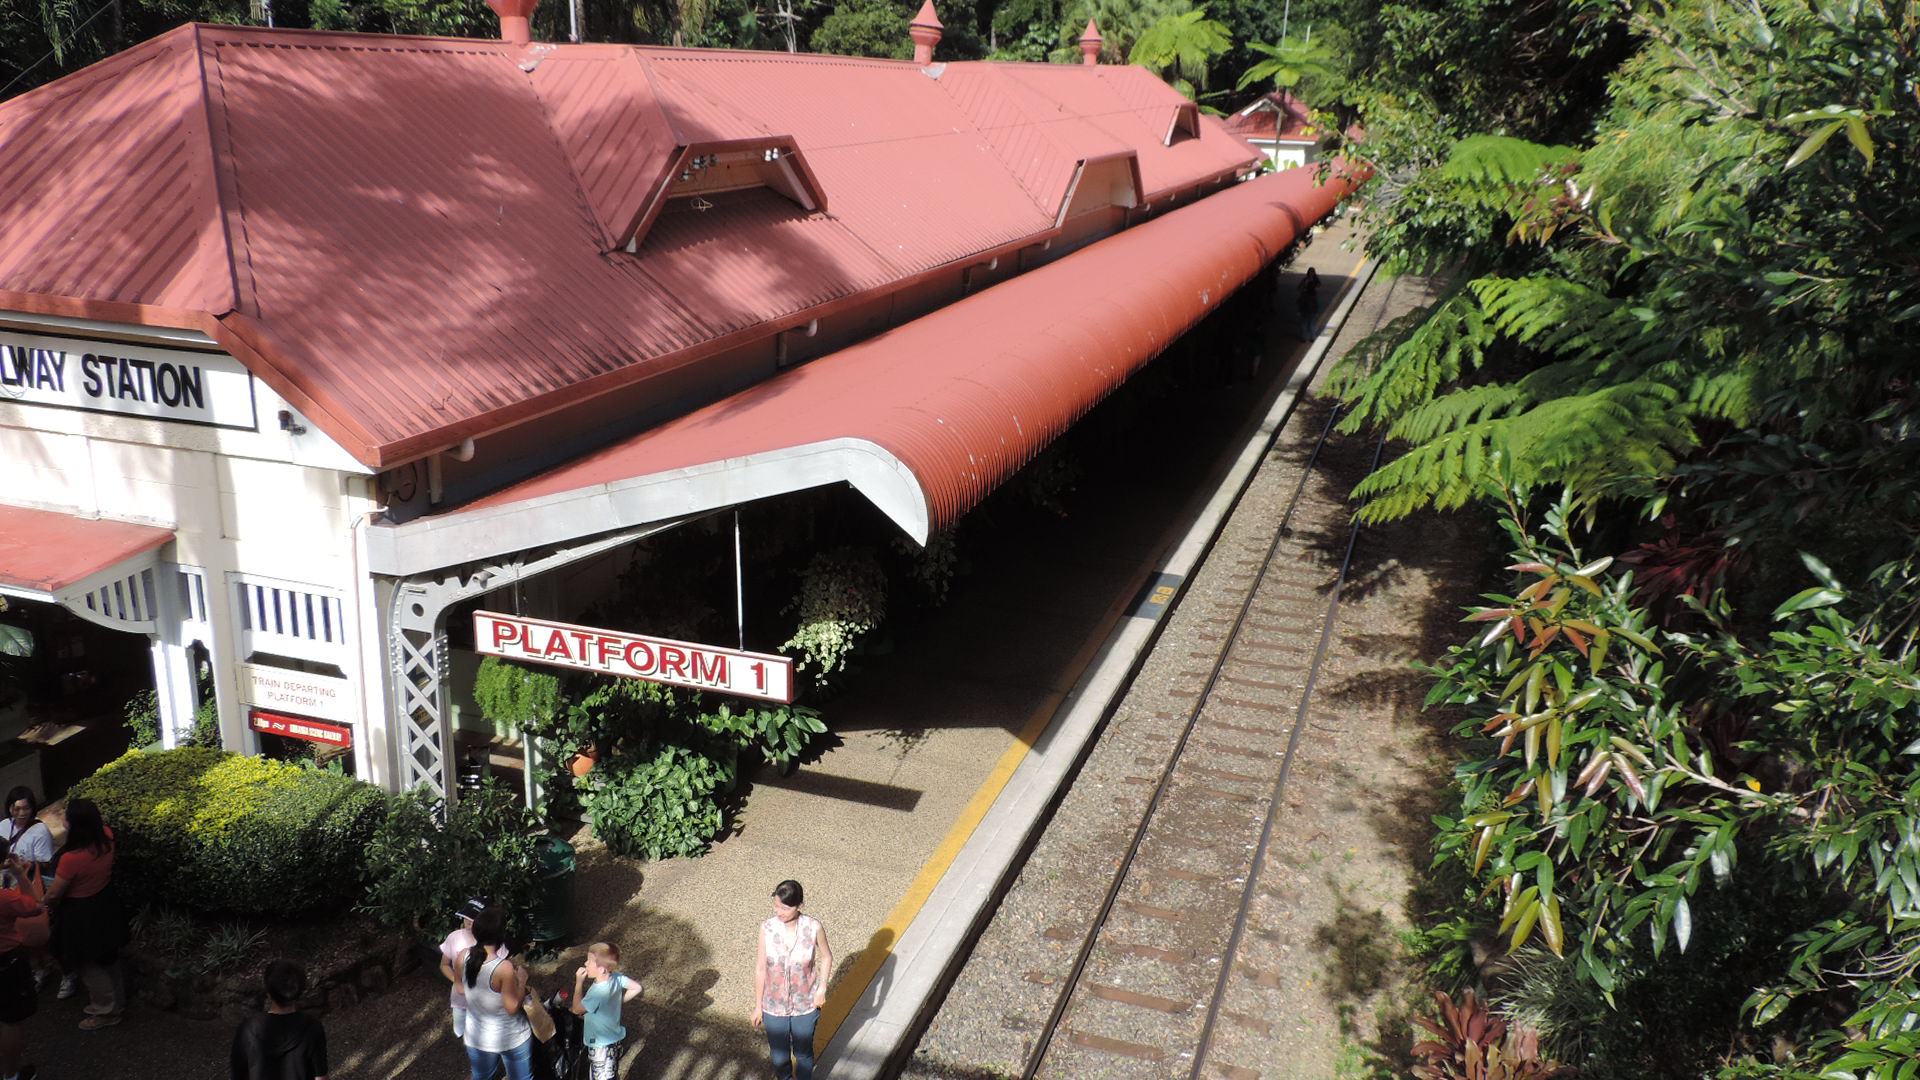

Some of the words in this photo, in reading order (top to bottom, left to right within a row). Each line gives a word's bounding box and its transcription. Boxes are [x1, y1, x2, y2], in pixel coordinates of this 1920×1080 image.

[81, 352, 204, 409] STATION
[491, 619, 731, 689] PLATFORM
[750, 661, 769, 695] 1
[251, 675, 281, 689] TRAIN
[283, 681, 337, 698] DEPARTING
[267, 690, 317, 707] PLATFORM
